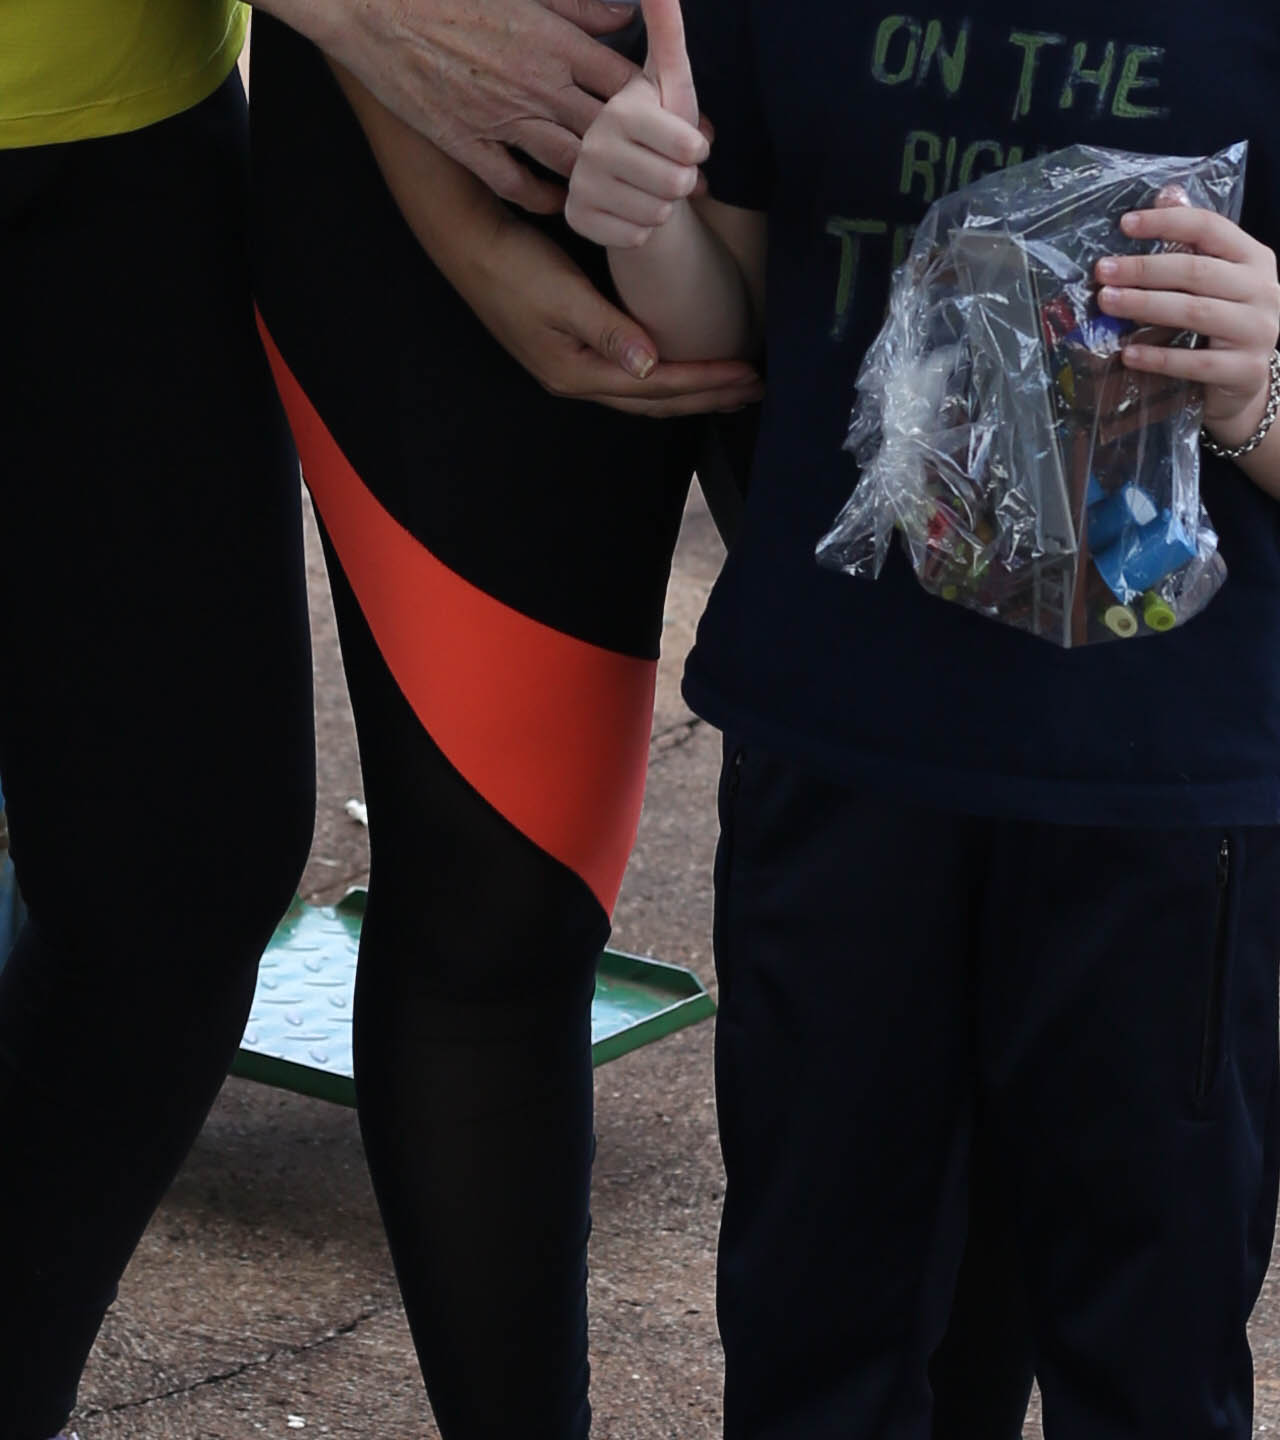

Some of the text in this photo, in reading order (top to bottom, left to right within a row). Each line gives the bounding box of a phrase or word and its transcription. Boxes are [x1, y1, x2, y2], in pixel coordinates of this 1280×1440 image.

[869, 13, 1170, 121] ON THE
[898, 130, 1046, 203] RIG
